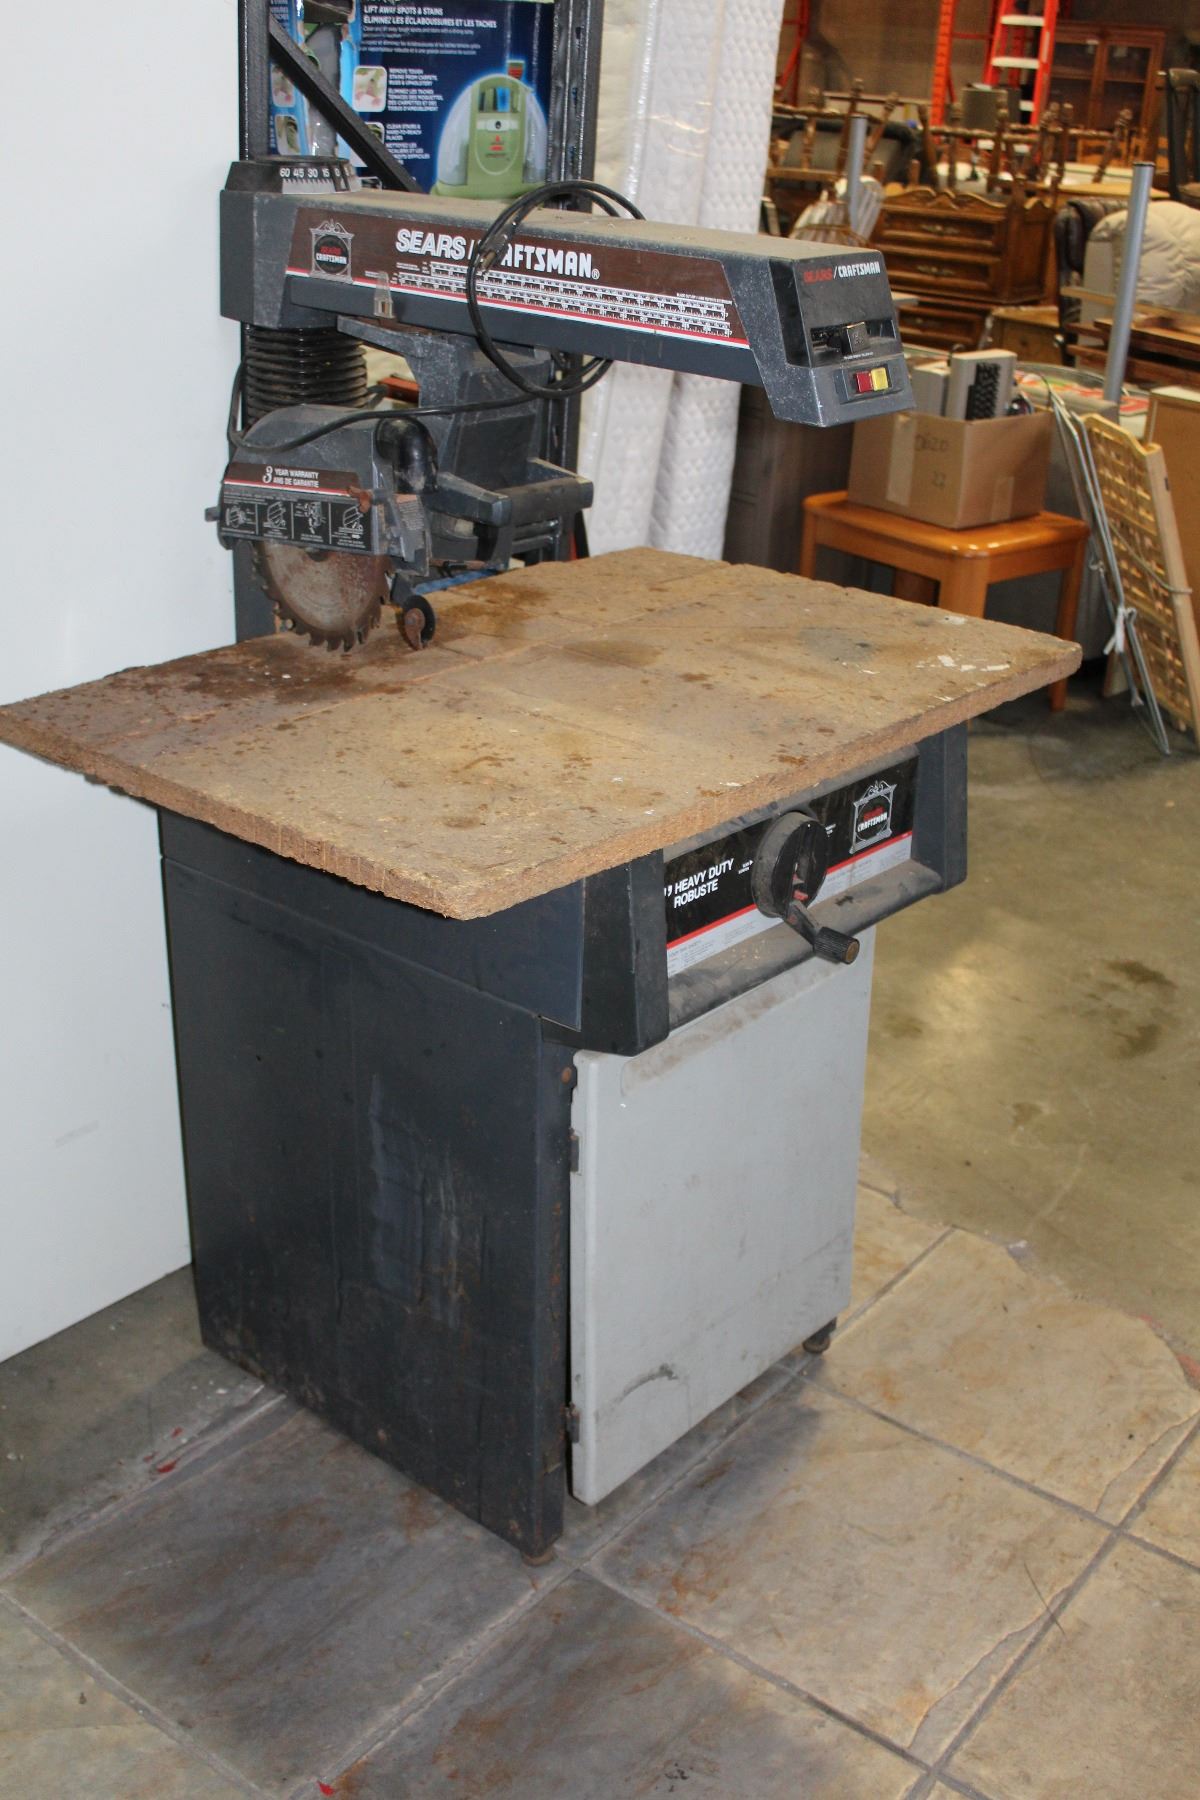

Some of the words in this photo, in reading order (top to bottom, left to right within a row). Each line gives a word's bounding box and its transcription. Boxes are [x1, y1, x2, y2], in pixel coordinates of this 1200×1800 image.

[363, 5, 378, 14] LIFT
[396, 7, 417, 15] SPOTS
[423, 8, 443, 16] STAINS
[392, 17, 404, 25] LES
[455, 19, 462, 27] ET
[464, 19, 474, 27] LES
[280, 167, 290, 178] 60
[293, 167, 304, 178] 45
[307, 168, 318, 178] 30
[322, 168, 330, 178] 15
[395, 228, 467, 261] SEARS
[262, 465, 273, 484] 3
[274, 468, 289, 476] YEAR
[289, 469, 319, 479] WARRANTY
[285, 477, 292, 485] DE
[293, 479, 320, 488] GARANTIE
[857, 811, 888, 833] CRAFTSMAN
[674, 870, 707, 895] HEAVY
[708, 857, 734, 880] DUTY
[673, 878, 719, 909] ROBUSTE
